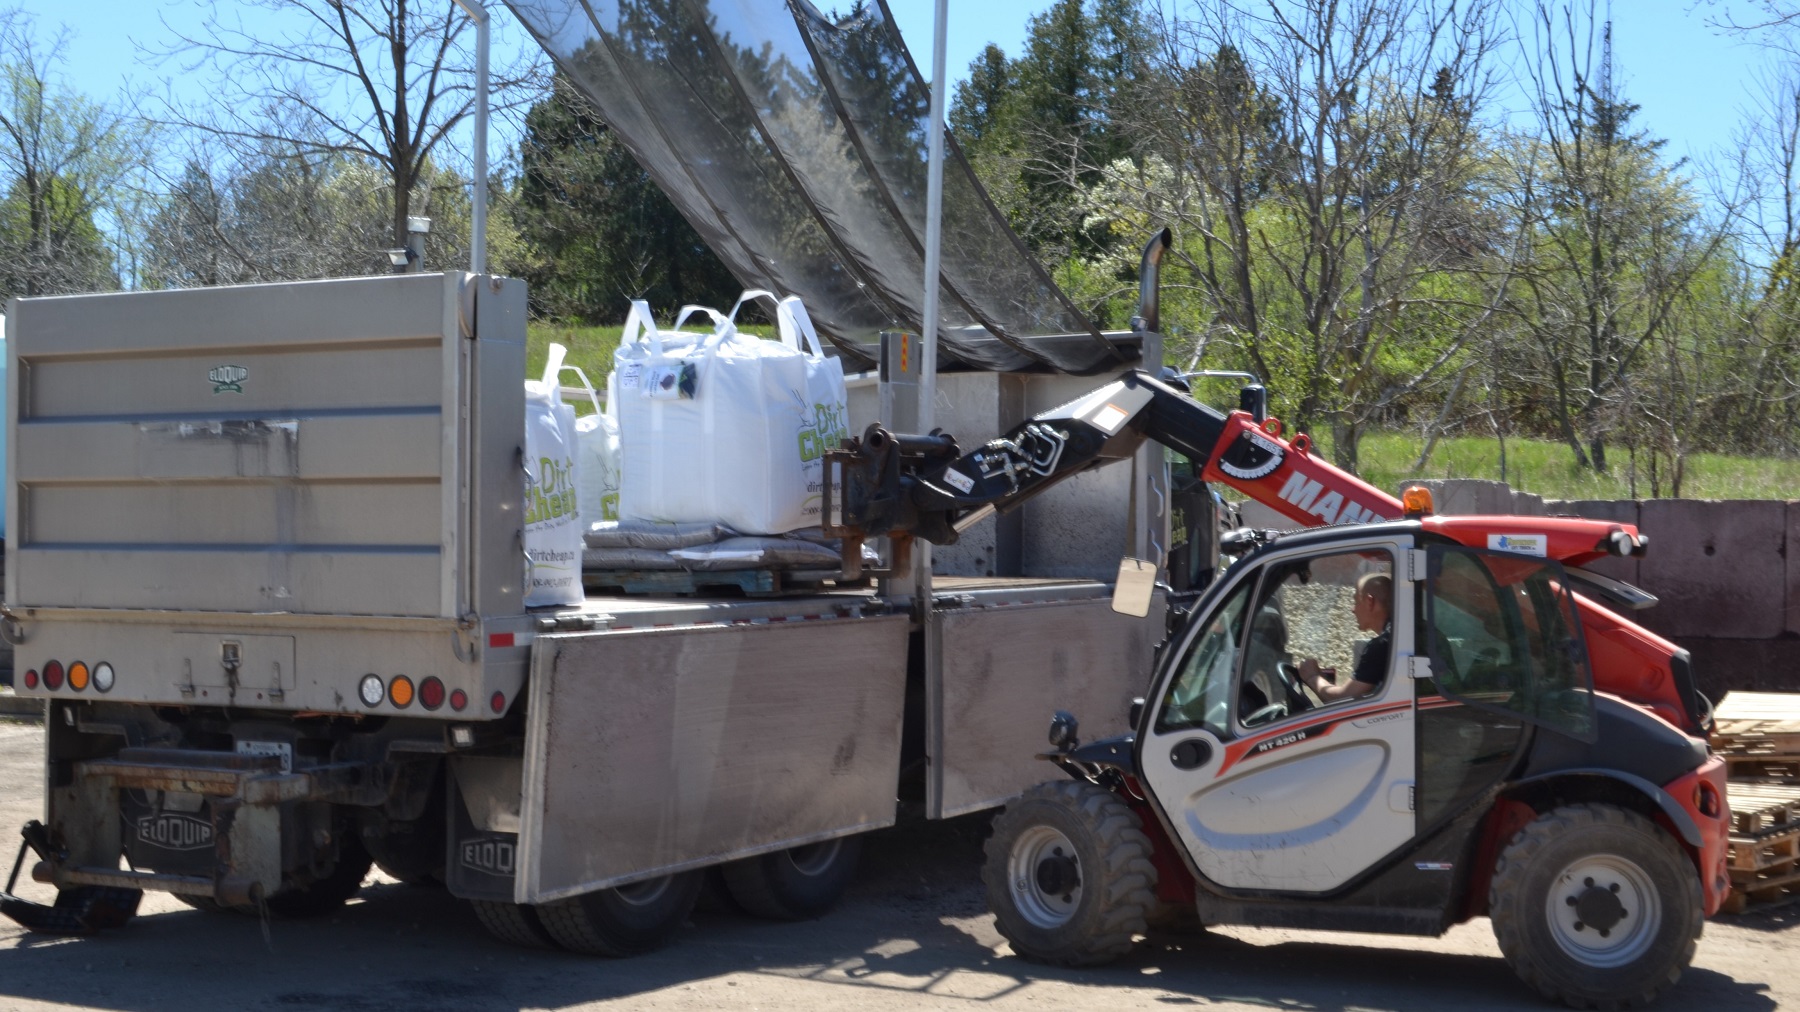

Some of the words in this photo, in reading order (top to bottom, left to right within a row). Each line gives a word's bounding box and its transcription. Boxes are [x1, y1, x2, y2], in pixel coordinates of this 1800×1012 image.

[210, 366, 247, 384] ELOQUIP
[814, 401, 845, 434] Dirt
[540, 456, 573, 494] Dirt
[1259, 742, 1274, 752] MT
[1275, 735, 1297, 746] 420
[141, 818, 211, 847] ELOQUIP
[465, 842, 514, 873] ELOQ
